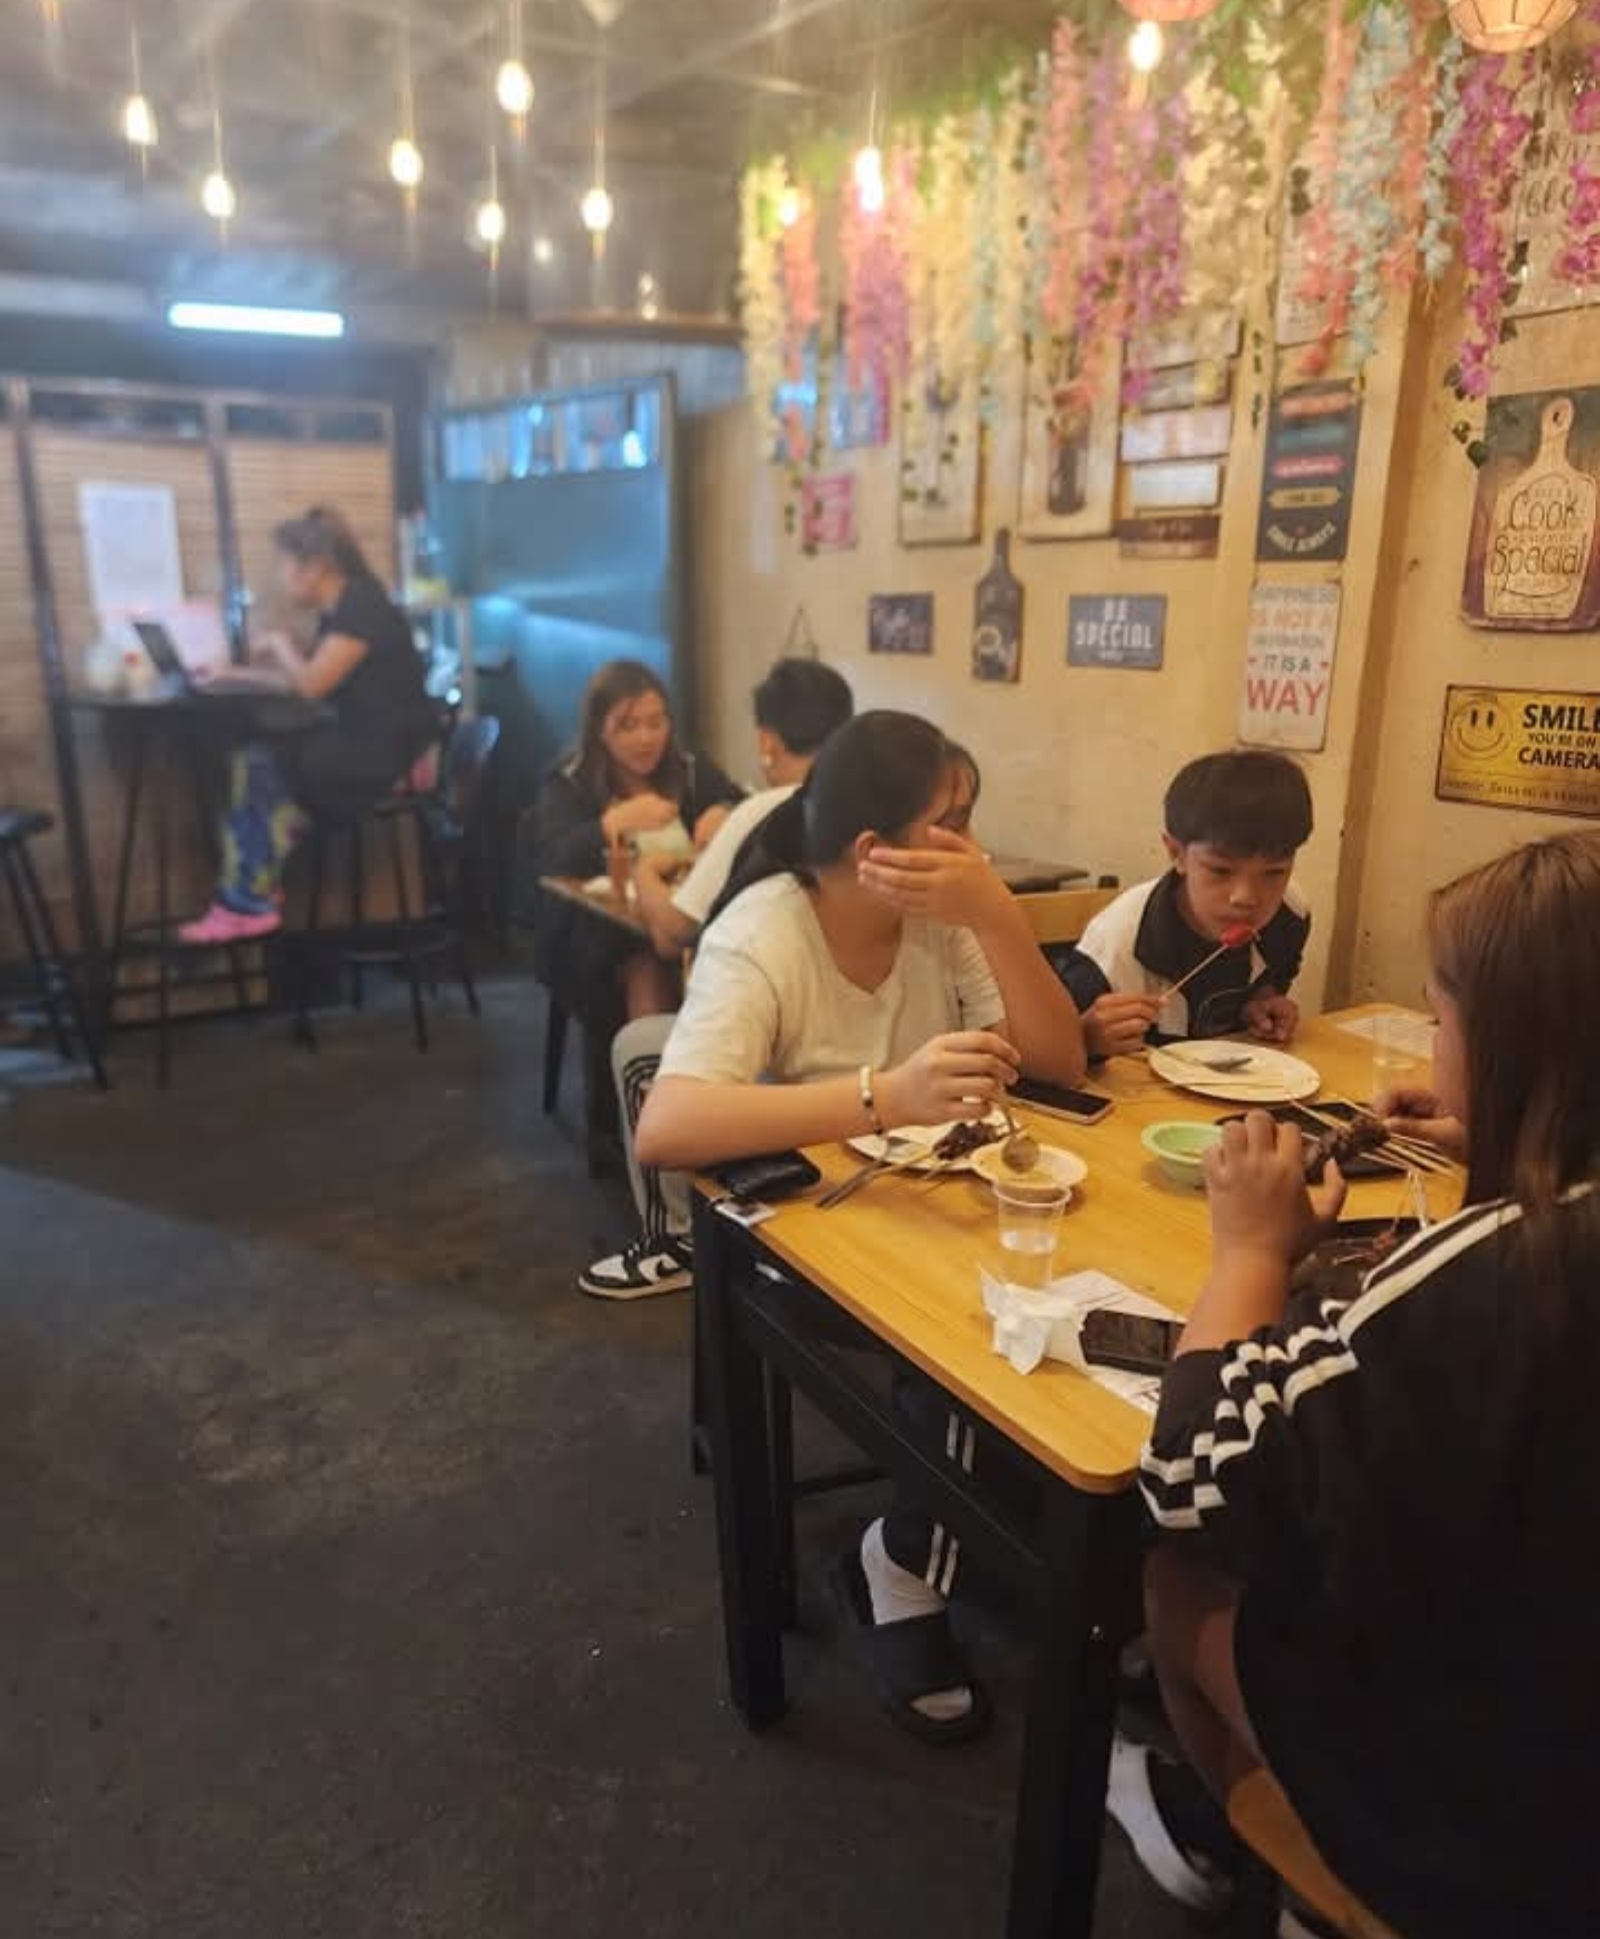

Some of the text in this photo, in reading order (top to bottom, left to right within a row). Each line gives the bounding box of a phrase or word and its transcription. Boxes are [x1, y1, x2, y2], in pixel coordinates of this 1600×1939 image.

[1503, 489, 1578, 531] Cook
[1490, 533, 1586, 577] Special
[1075, 622, 1154, 649] SPECIAL
[1264, 654, 1311, 672] IT IS A
[1247, 678, 1324, 716] WAY
[1576, 735, 1597, 749] ON
[1518, 746, 1600, 770] CAMERA
